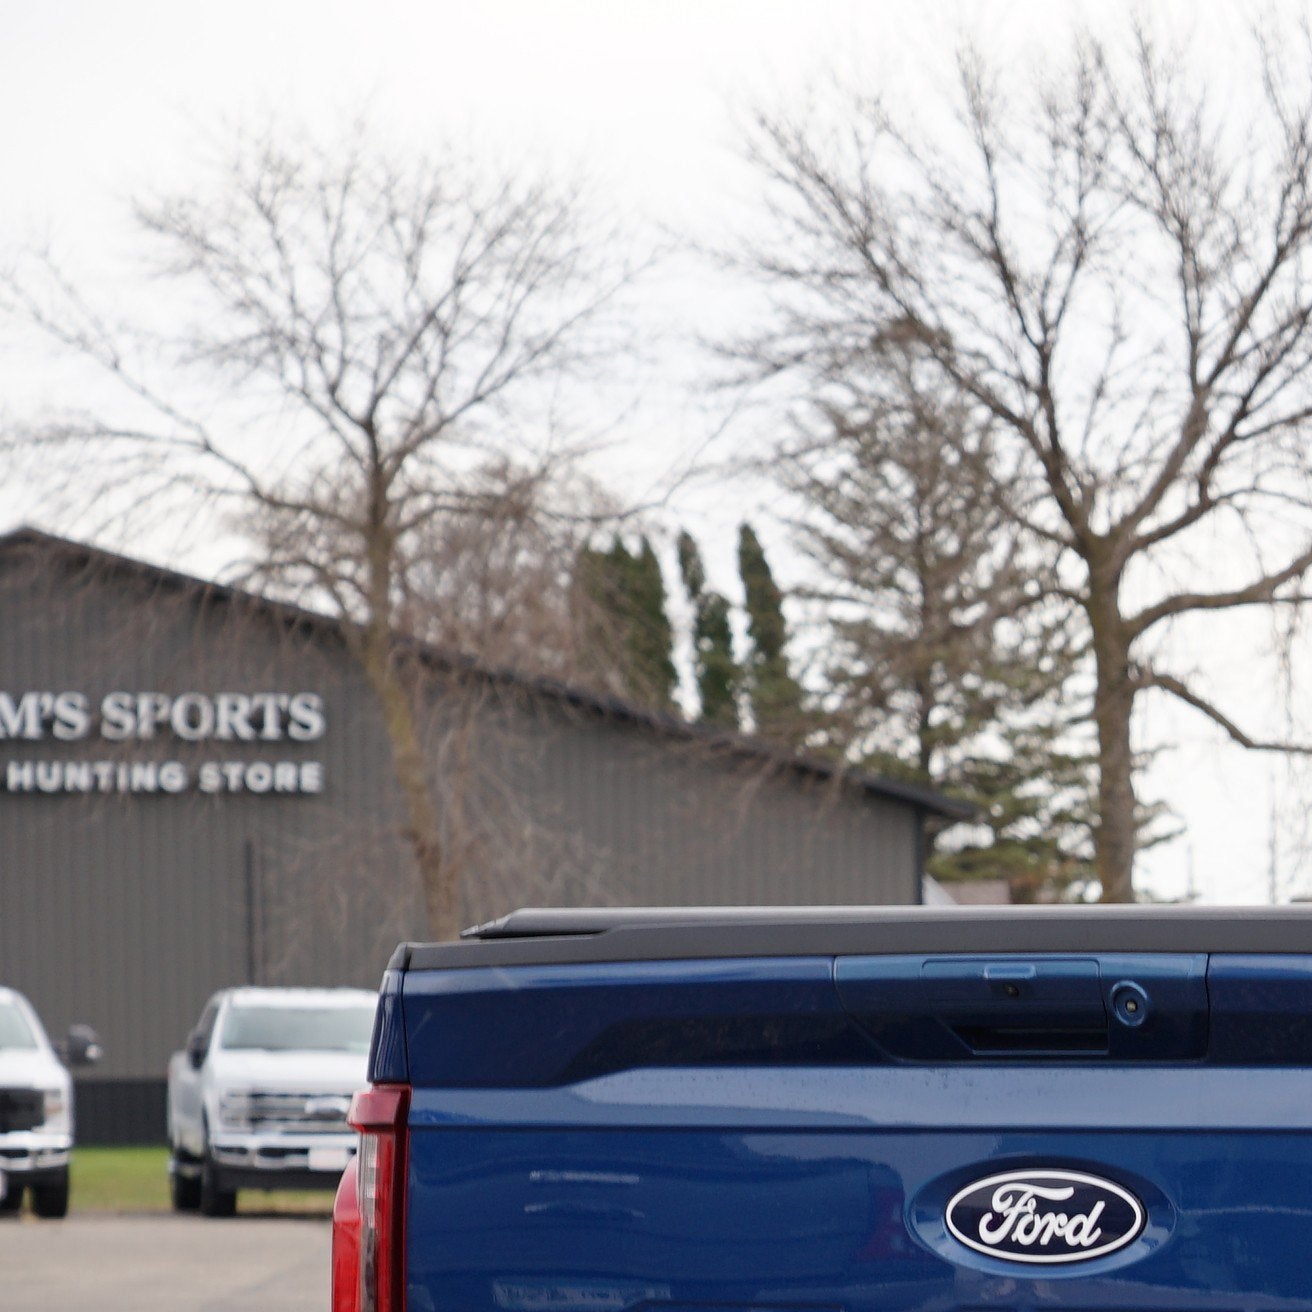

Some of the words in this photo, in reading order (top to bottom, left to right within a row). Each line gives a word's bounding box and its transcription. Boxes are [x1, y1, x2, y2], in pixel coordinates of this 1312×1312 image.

[101, 691, 326, 742] SPORTS
[6, 760, 188, 792] HUNTING
[199, 760, 323, 793] STORE
[978, 1183, 1105, 1247] Ford
